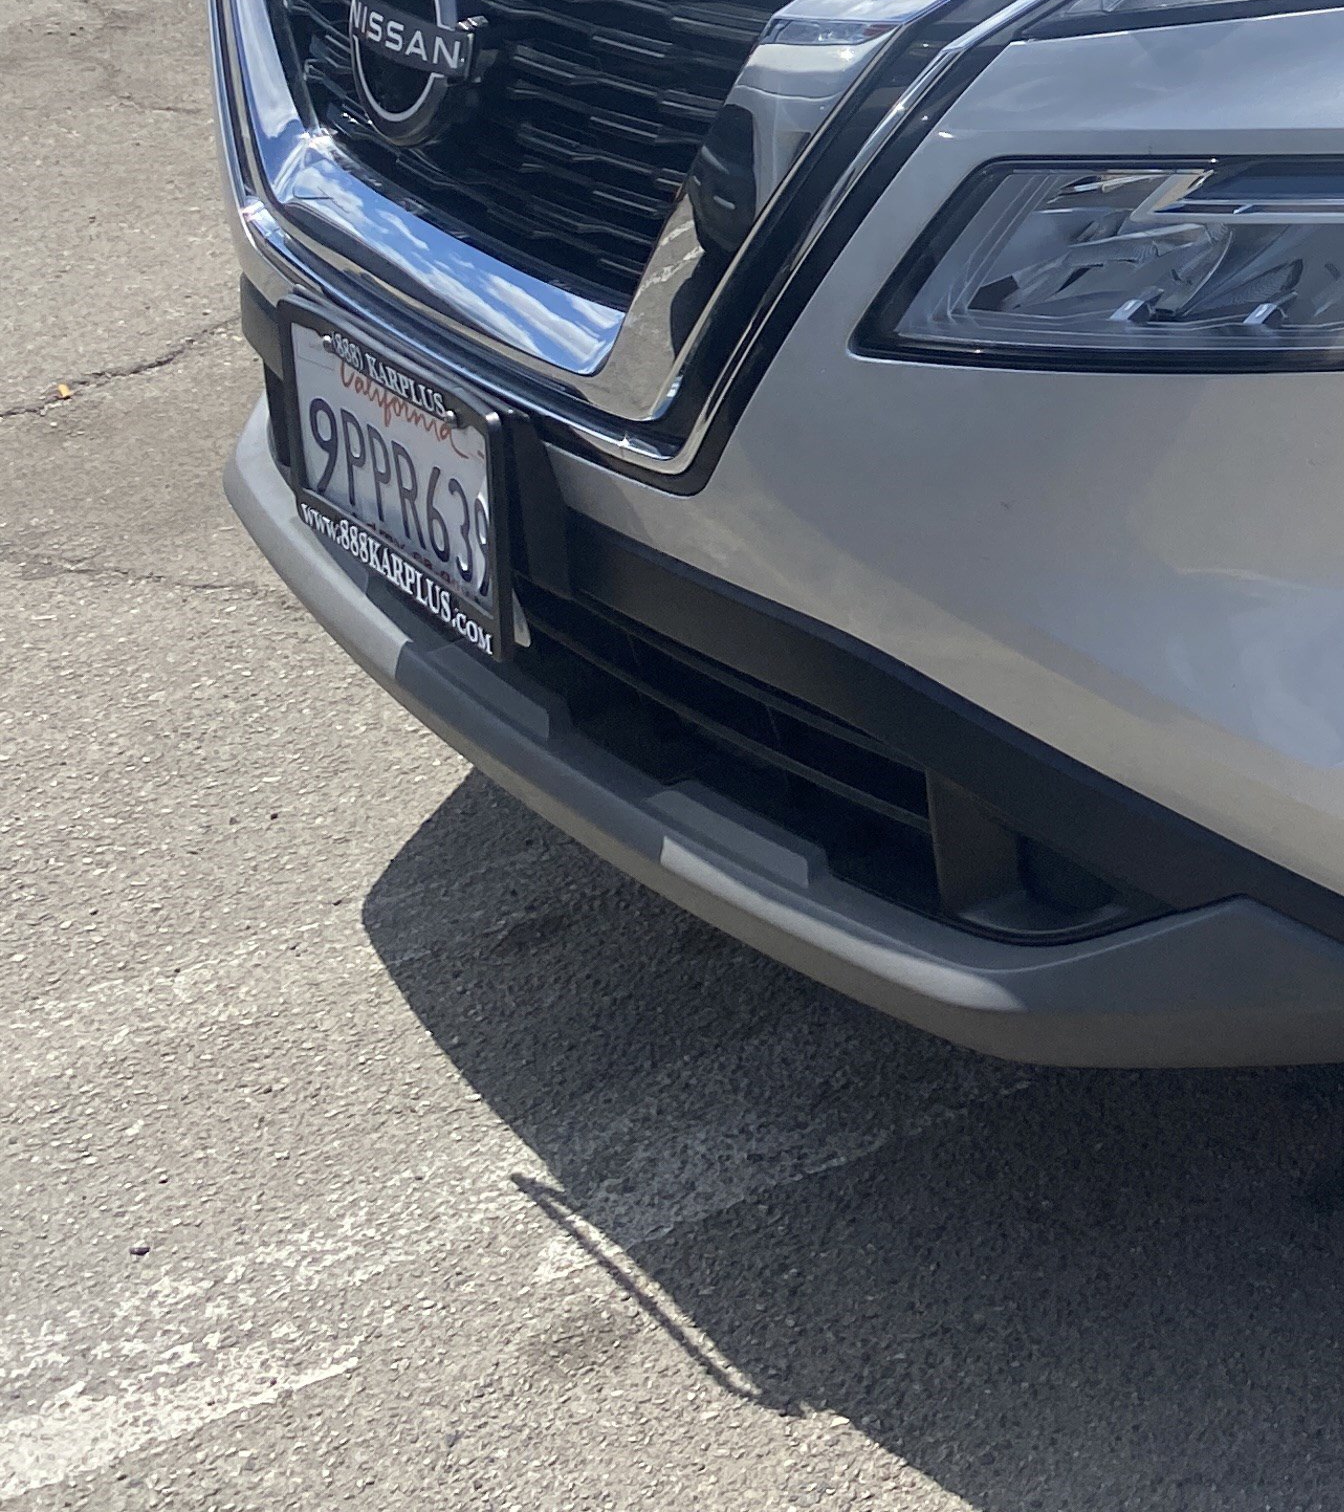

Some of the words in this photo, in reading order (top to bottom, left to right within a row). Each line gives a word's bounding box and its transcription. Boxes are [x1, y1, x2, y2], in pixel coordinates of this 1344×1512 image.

[351, 0, 462, 71] NISSAN
[331, 331, 364, 371] (888)
[365, 353, 447, 418] KARPLUS
[309, 397, 490, 597] 9PPR639
